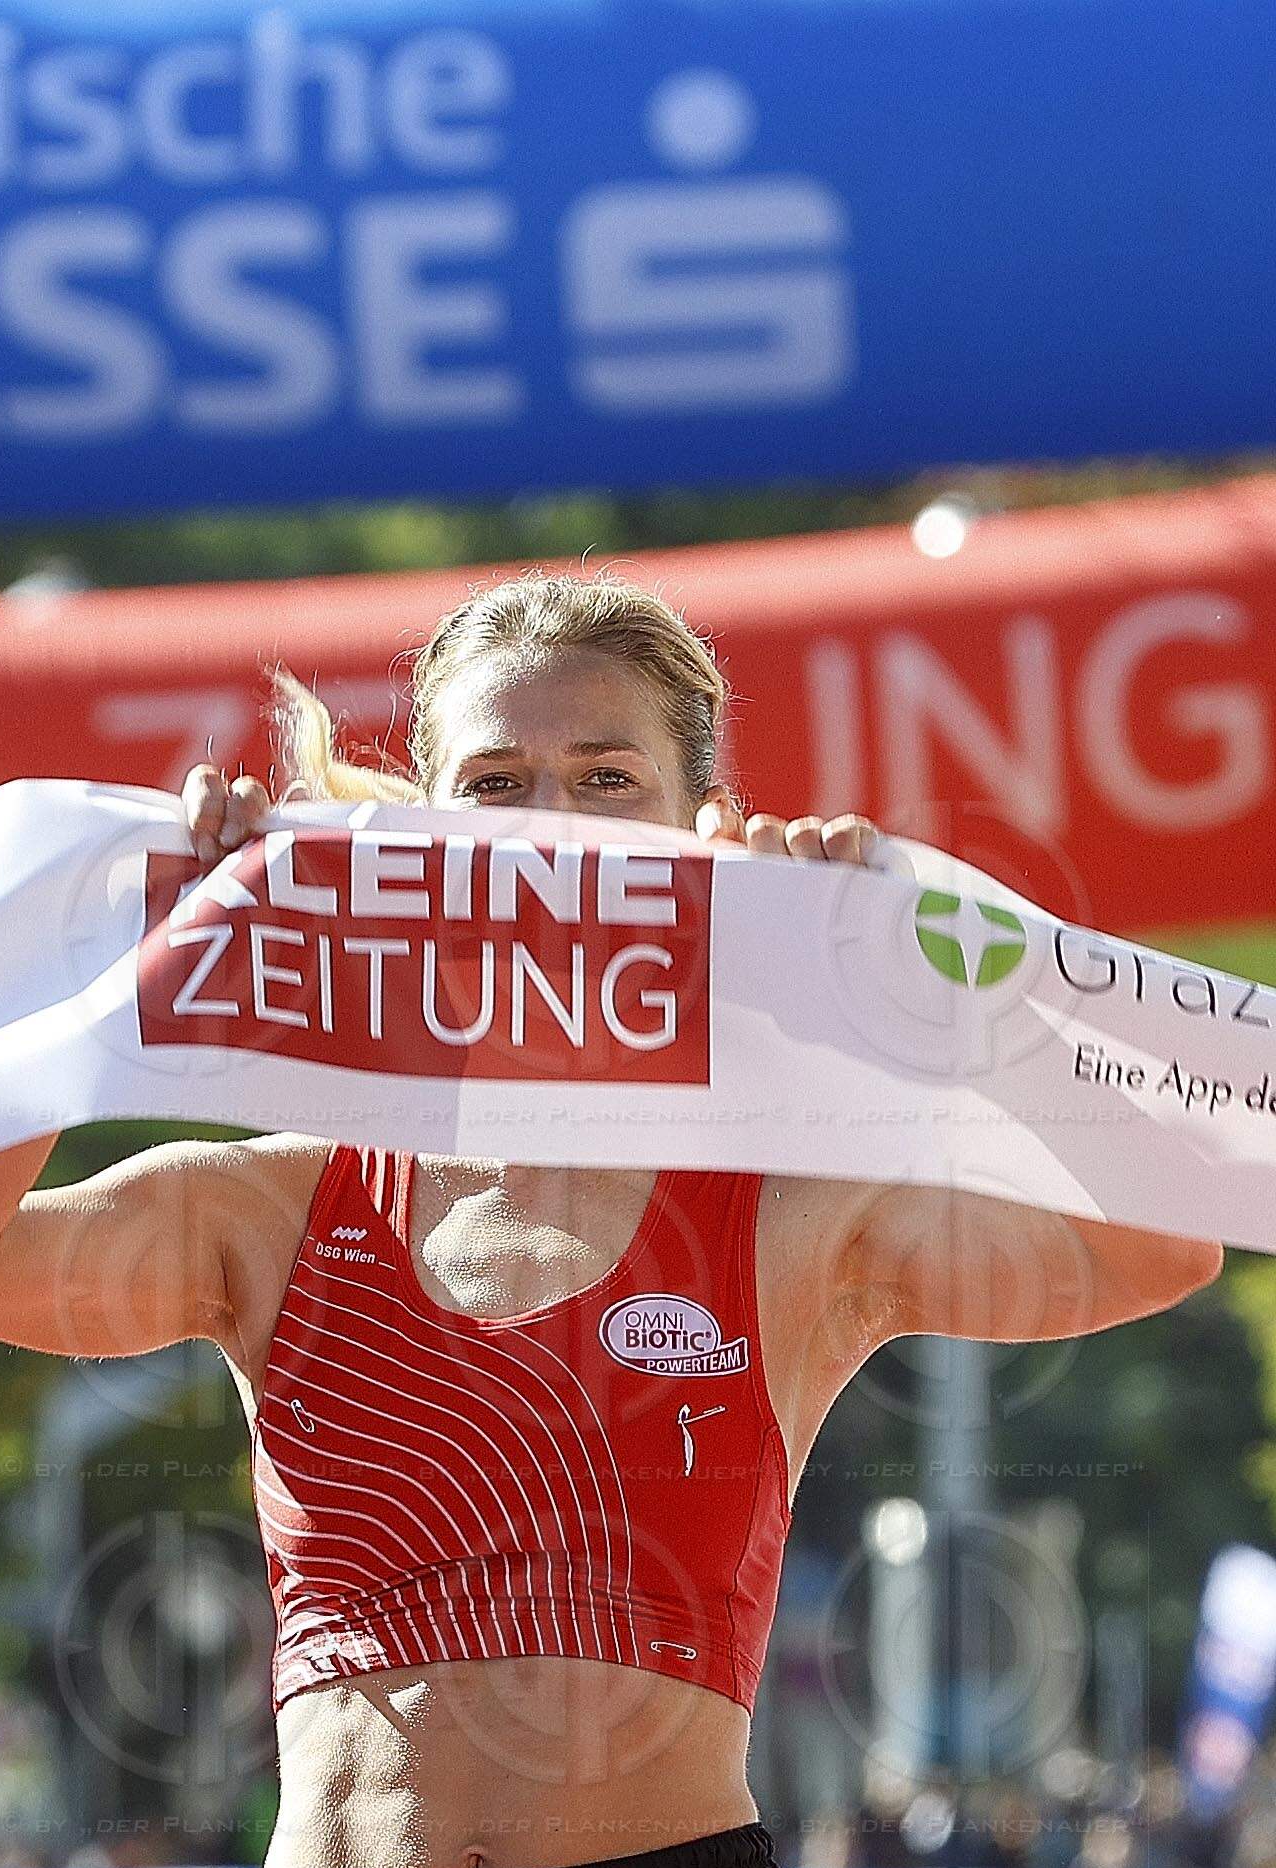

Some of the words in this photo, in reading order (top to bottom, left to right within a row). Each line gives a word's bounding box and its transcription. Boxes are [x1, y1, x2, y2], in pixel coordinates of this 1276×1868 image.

[167, 922, 678, 1053] ZEITUNG
[1052, 926, 1272, 1029] Graz
[1074, 1043, 1146, 1090] Eine
[1156, 1057, 1232, 1116] App
[315, 1241, 342, 1260] DSG
[344, 1248, 376, 1264] Wien
[646, 1345, 741, 1373] POWERTEAM
